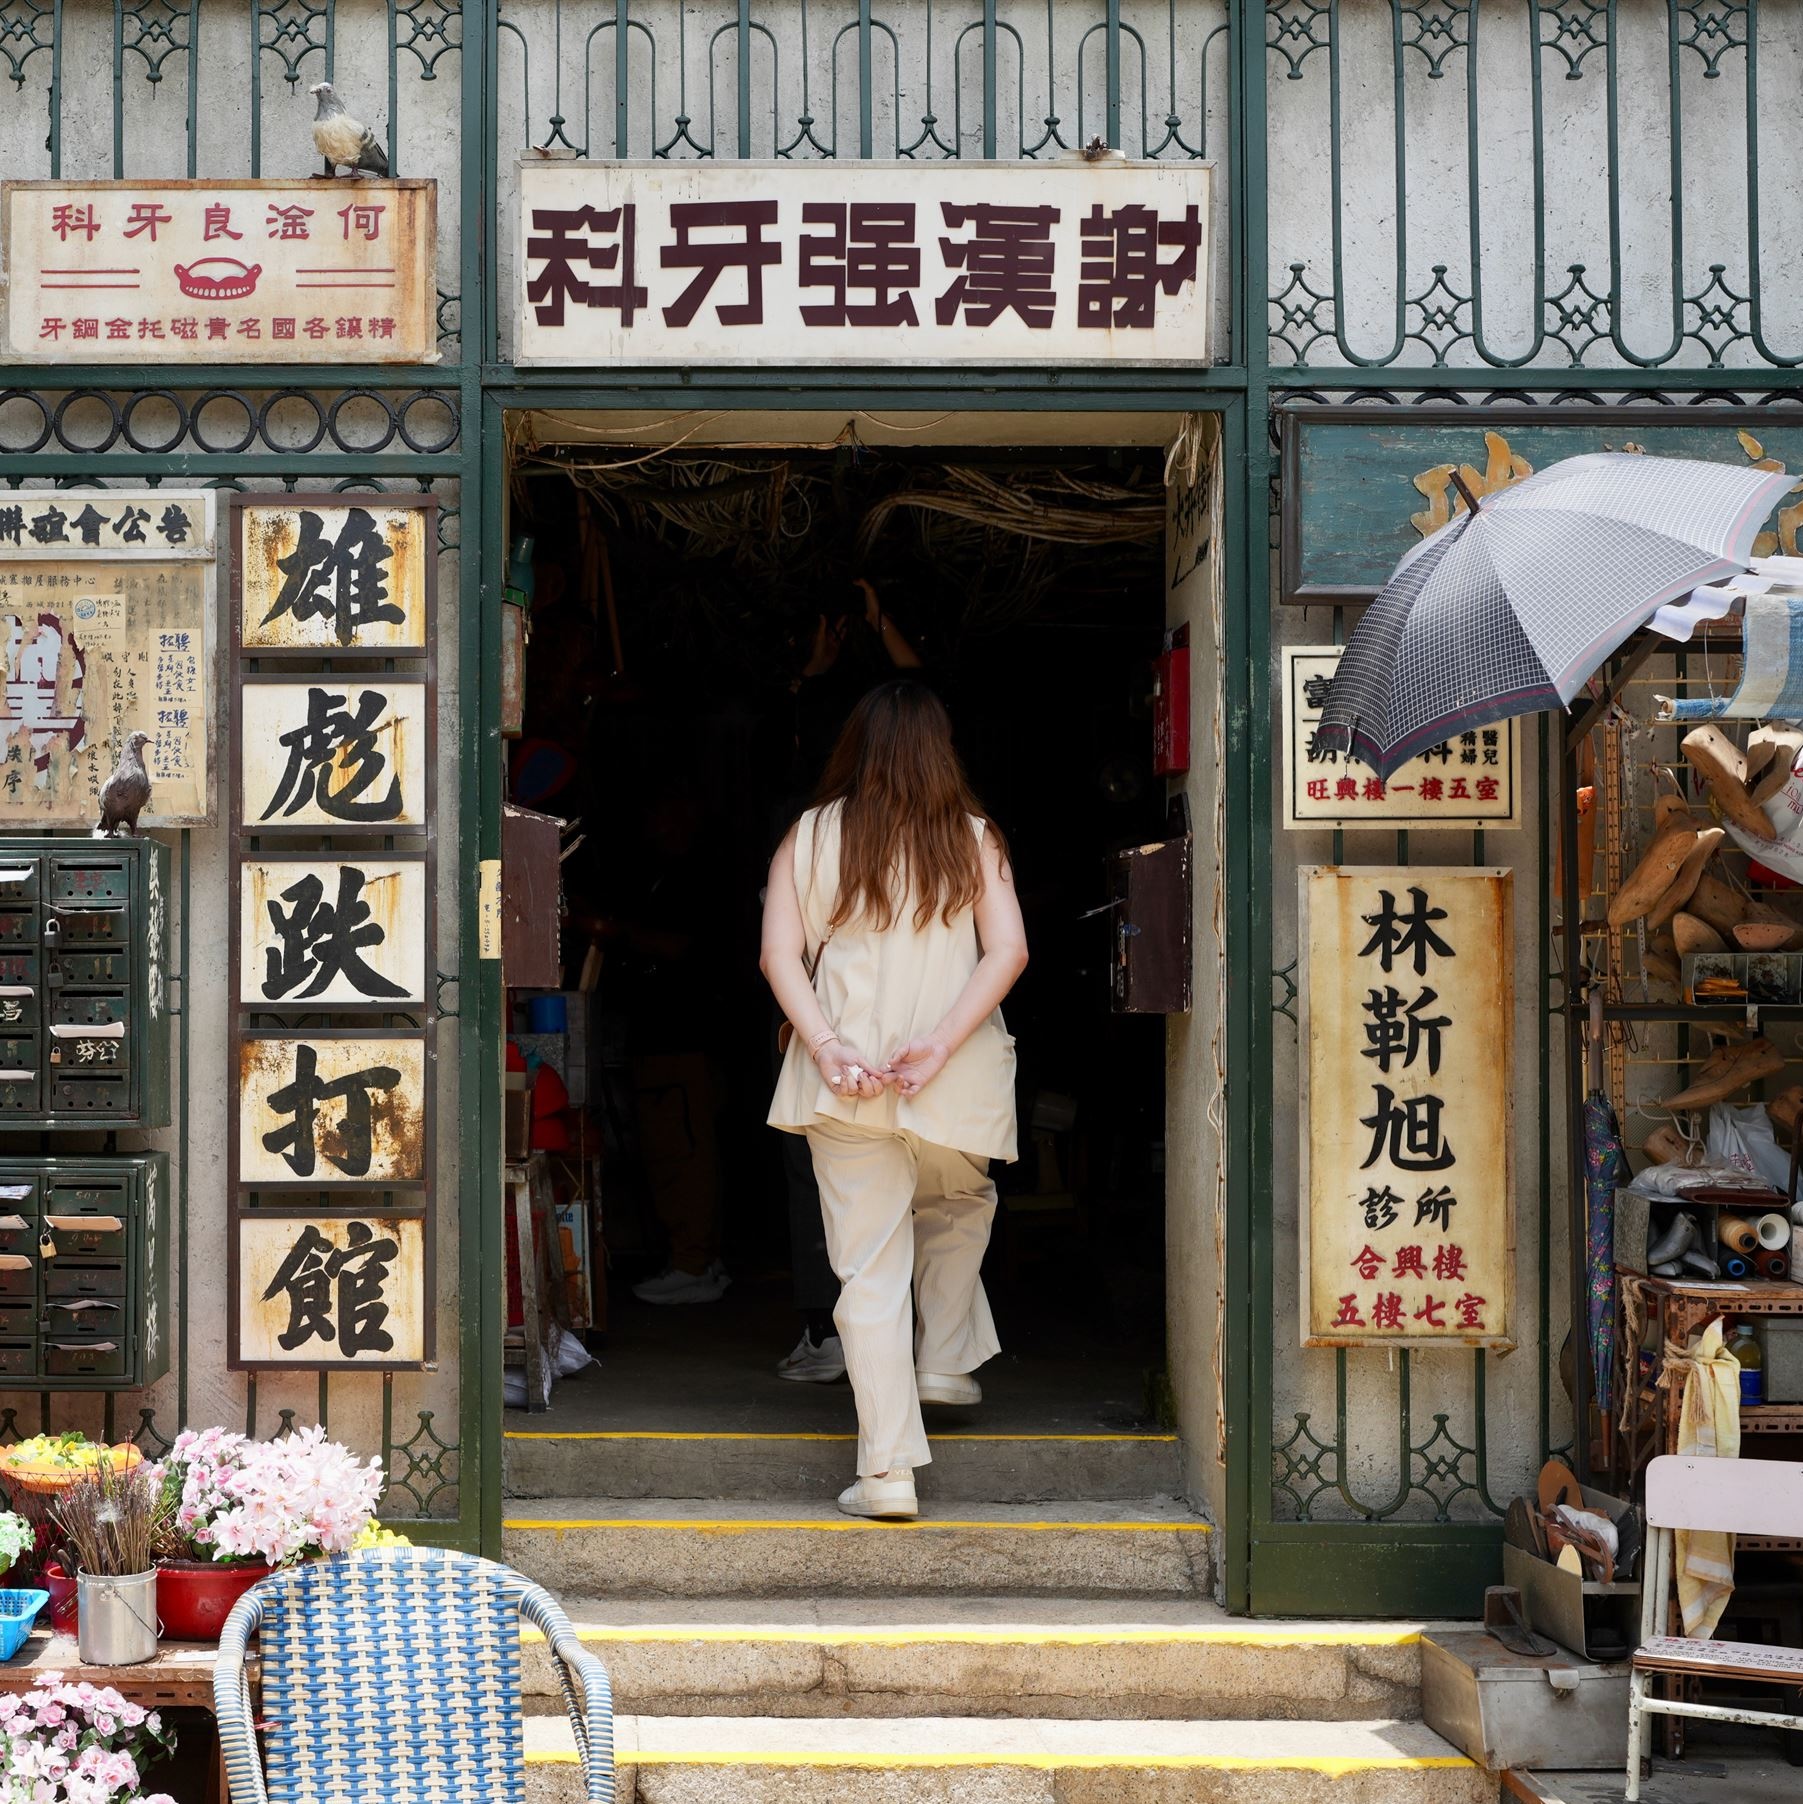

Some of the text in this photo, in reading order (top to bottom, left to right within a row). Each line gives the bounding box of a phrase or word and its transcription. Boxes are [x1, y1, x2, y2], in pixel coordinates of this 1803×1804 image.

[1358, 1185, 1458, 1233] 診所
[1350, 1243, 1469, 1282] 合興樓
[1331, 1292, 1487, 1331] 五樓七室
